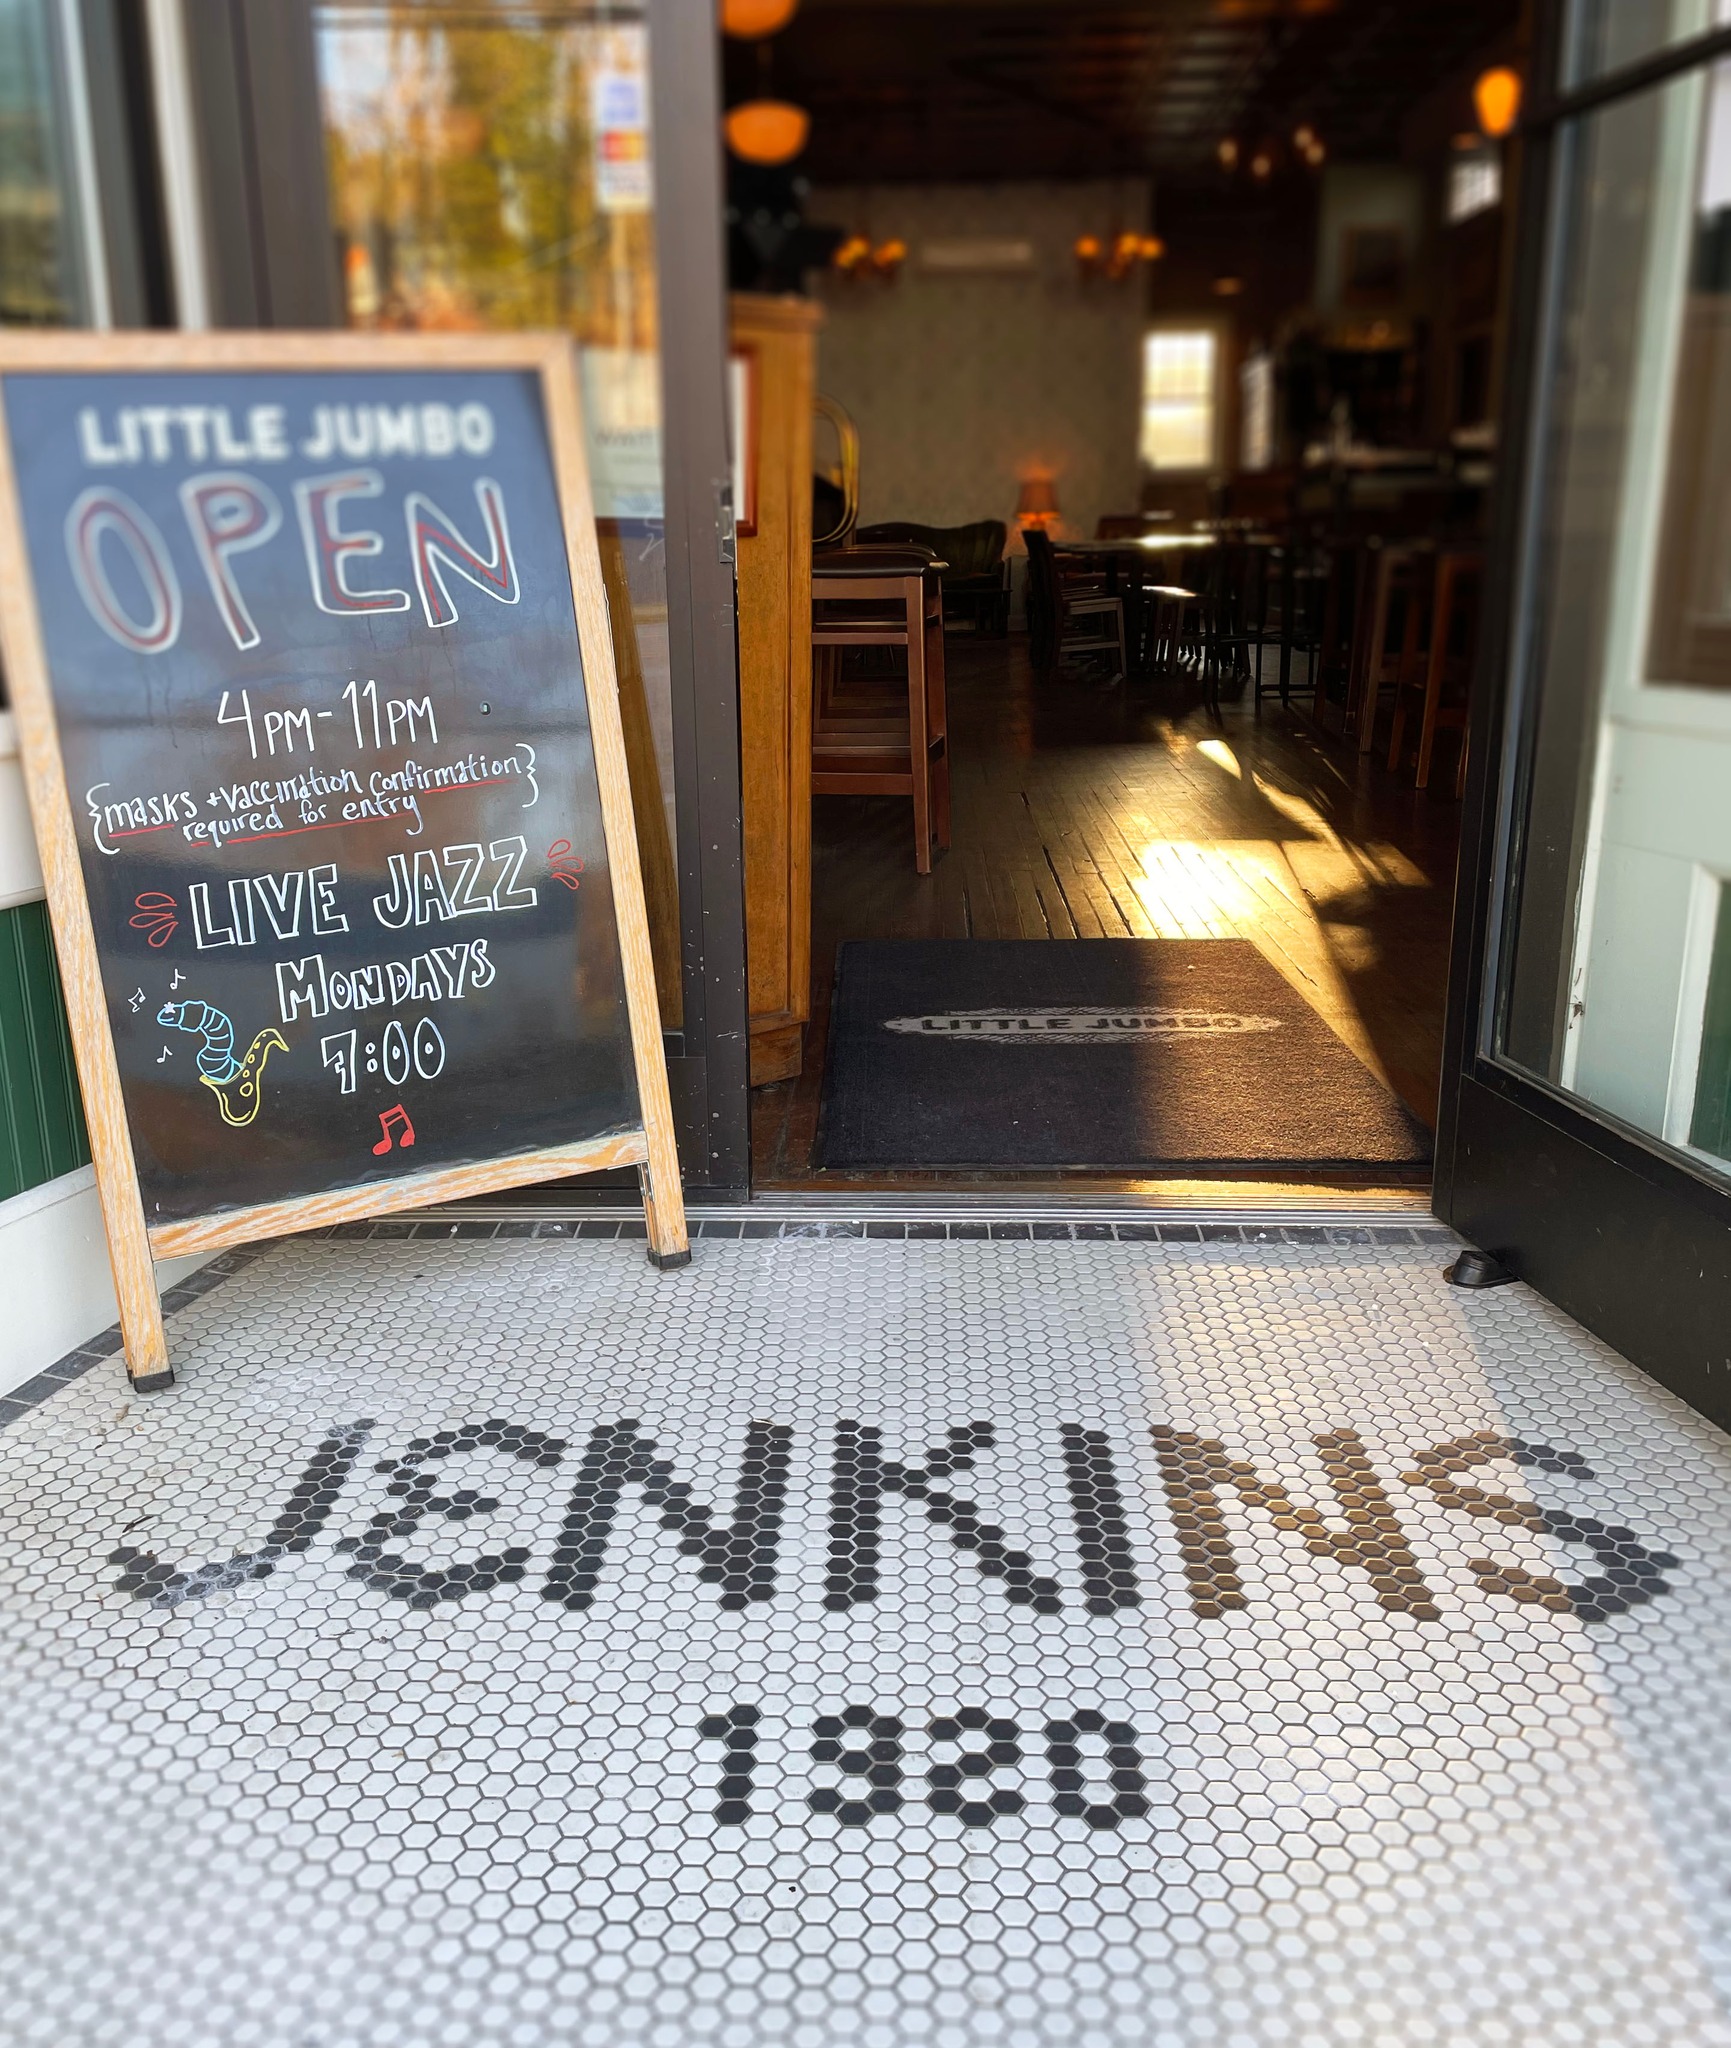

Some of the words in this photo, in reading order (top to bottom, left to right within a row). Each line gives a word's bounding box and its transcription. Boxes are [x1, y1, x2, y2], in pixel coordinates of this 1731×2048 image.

[80, 407, 288, 463] LITTLE
[303, 402, 495, 457] JUMBO
[64, 469, 520, 654] OPEN
[182, 803, 284, 849] required
[298, 799, 327, 826] for
[342, 794, 424, 836] entry
[189, 863, 348, 949] LIVE
[372, 835, 538, 929] JAZZ
[320, 1016, 446, 1094] 7:00
[921, 1017, 1072, 1031] LITTLE
[1086, 1016, 1244, 1030] JUMBO
[106, 1416, 1680, 1622] JENKINS
[698, 1703, 1151, 1831] 1920
